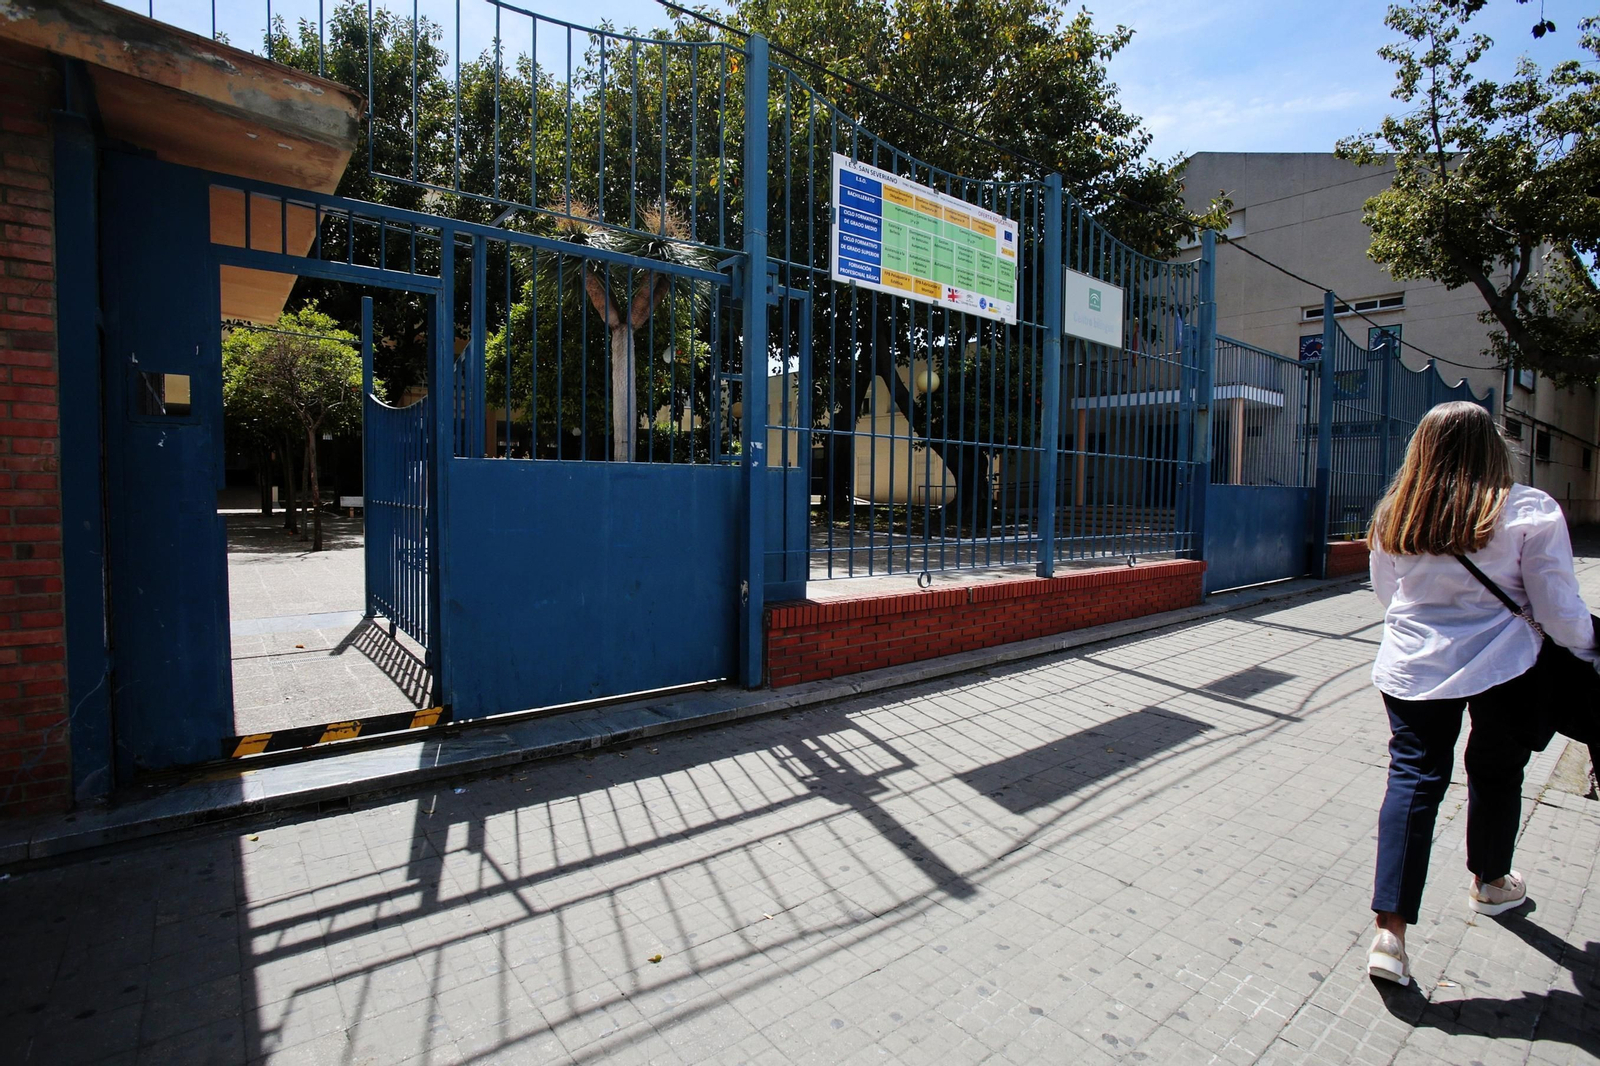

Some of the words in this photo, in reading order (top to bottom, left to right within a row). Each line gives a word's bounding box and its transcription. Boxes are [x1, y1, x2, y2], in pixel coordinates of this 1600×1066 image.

[845, 161, 858, 170] I.E.S.
[859, 165, 869, 174] SAN
[870, 169, 898, 184] SEVERIANO
[856, 176, 867, 184] E.S.O.
[847, 190, 876, 204] BACHILLERATO
[843, 209, 855, 217] CICLO
[855, 212, 878, 224] FORMATIVO
[978, 211, 992, 220] OFERTA
[993, 216, 1014, 229] EDUCATIVA
[850, 220, 864, 228] GRADO
[864, 224, 878, 232] MEDIO
[855, 238, 878, 249] FORMATIVO
[846, 244, 860, 253] GRADO
[861, 248, 880, 258] SUPERIOR
[848, 261, 872, 272] FORMACIÓN
[840, 267, 866, 279] PROFESIONAL
[866, 273, 880, 282] BÁSICA
